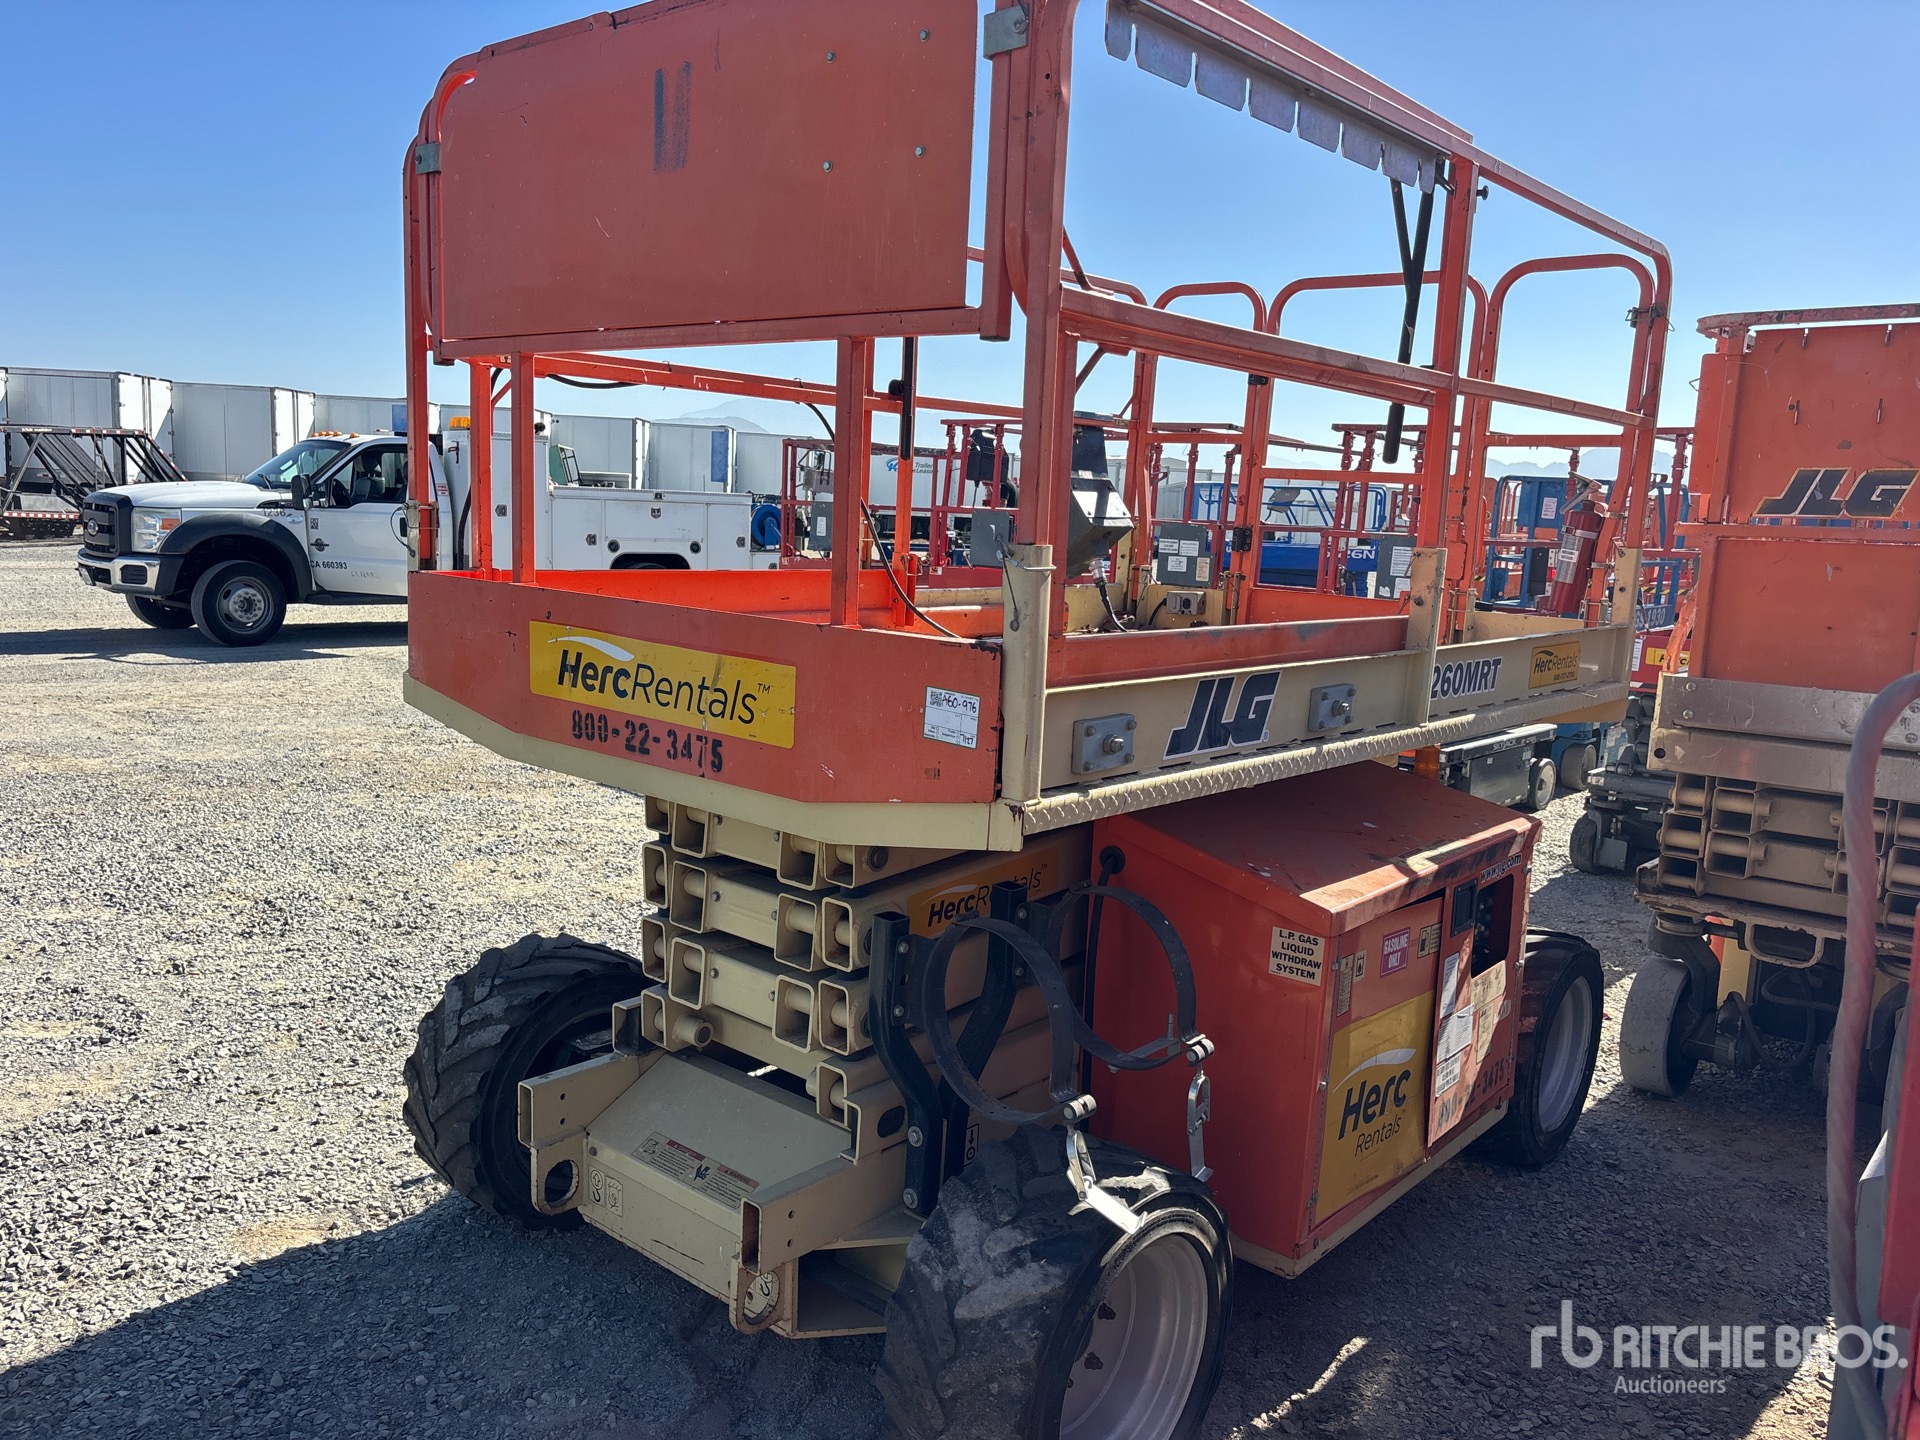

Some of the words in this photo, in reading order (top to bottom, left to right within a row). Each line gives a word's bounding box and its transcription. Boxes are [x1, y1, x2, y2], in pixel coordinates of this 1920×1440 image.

[1752, 467, 1920, 519] JLG
[322, 560, 348, 570] 660393
[1533, 651, 1578, 674] HercRentals
[1163, 670, 1282, 760] JLG
[1279, 929, 1295, 940] L.P.
[1298, 934, 1319, 946] GAS
[1281, 941, 1314, 956] LIQUID
[1272, 950, 1321, 970] WITHDRAW
[1276, 963, 1316, 980] SYSTEM
[1338, 1069, 1411, 1141] Herc
[1355, 1113, 1402, 1158] Rentals
